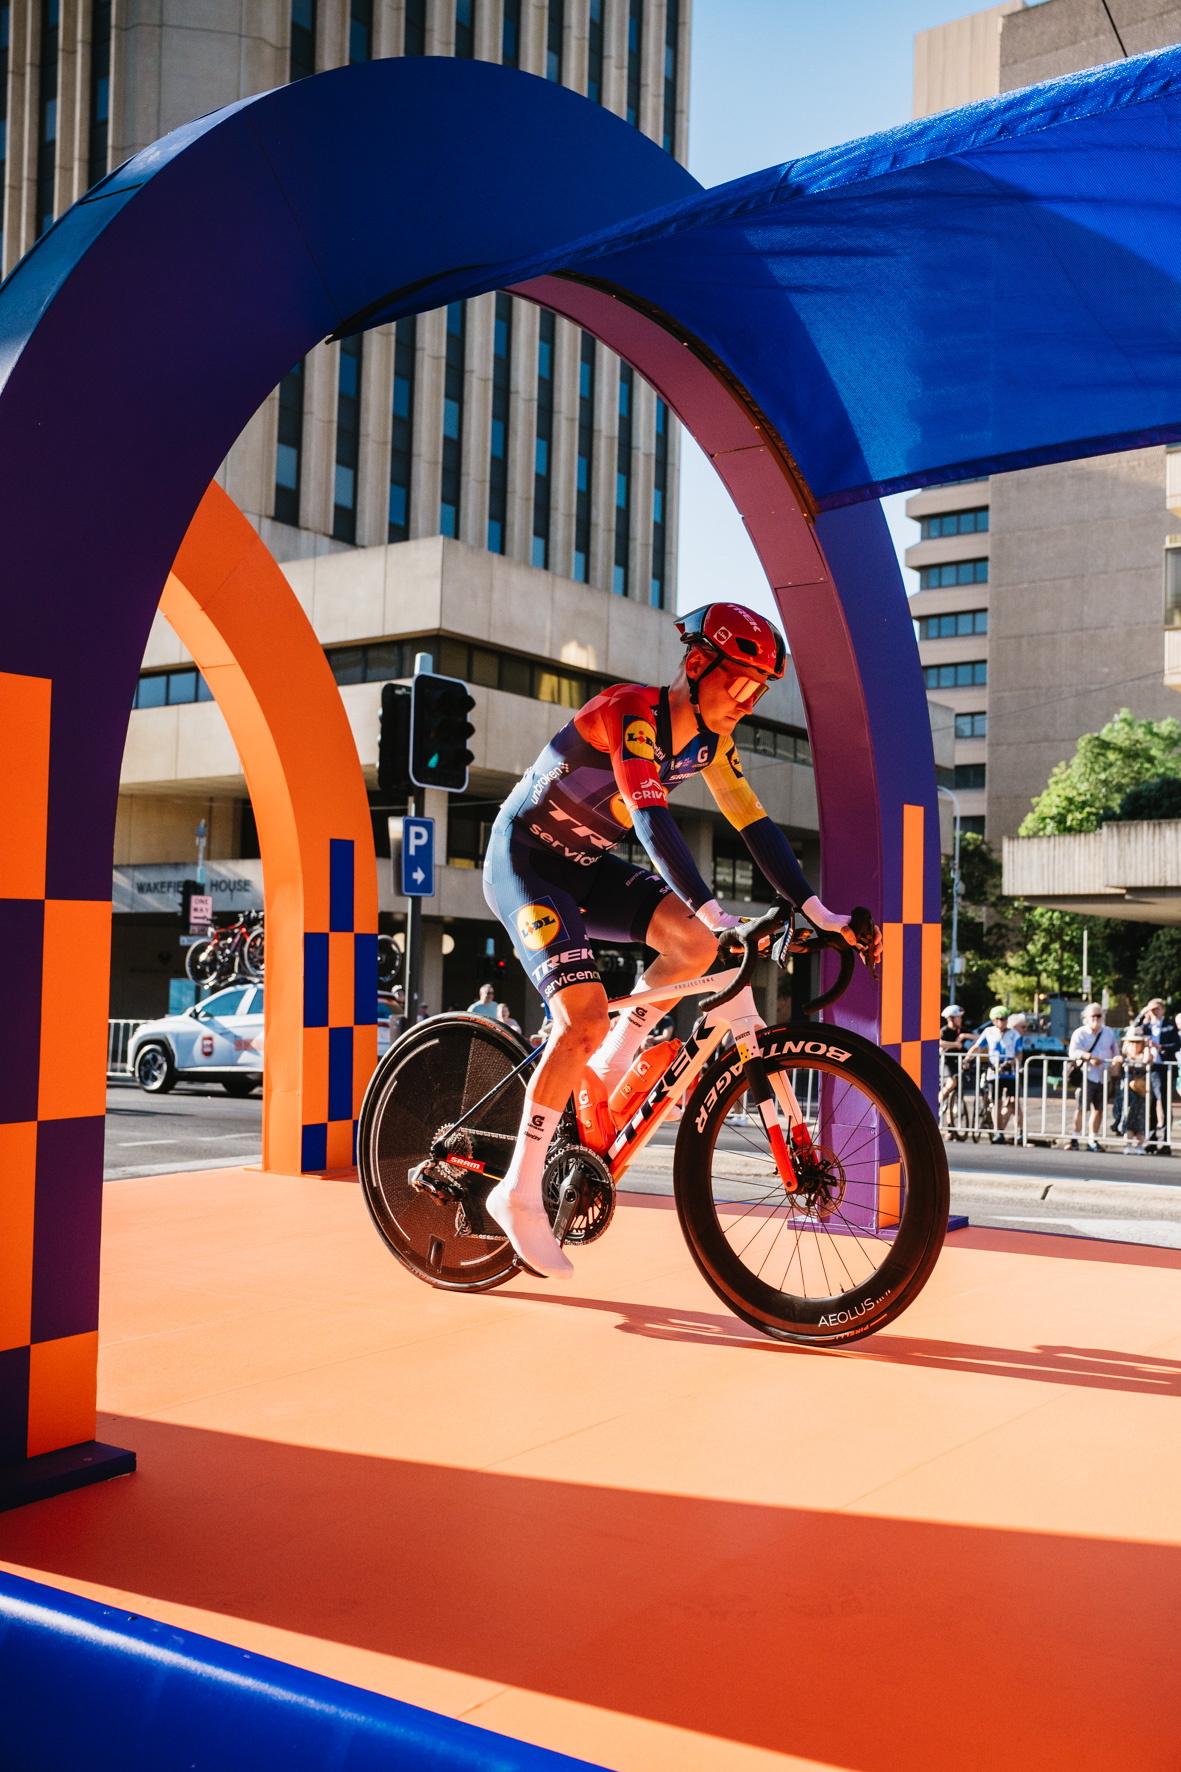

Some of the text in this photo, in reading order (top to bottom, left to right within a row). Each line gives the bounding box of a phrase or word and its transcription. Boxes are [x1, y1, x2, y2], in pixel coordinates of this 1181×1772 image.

[727, 604, 762, 633] TREK
[530, 765, 563, 805] unbroken
[408, 825, 428, 856] P
[136, 879, 249, 895] WAKEFIE HOUSE
[531, 948, 595, 982] TREK
[695, 1040, 853, 1134] BONTAGER
[449, 1156, 481, 1170] SRAM
[817, 1297, 876, 1328] AEOLUS
